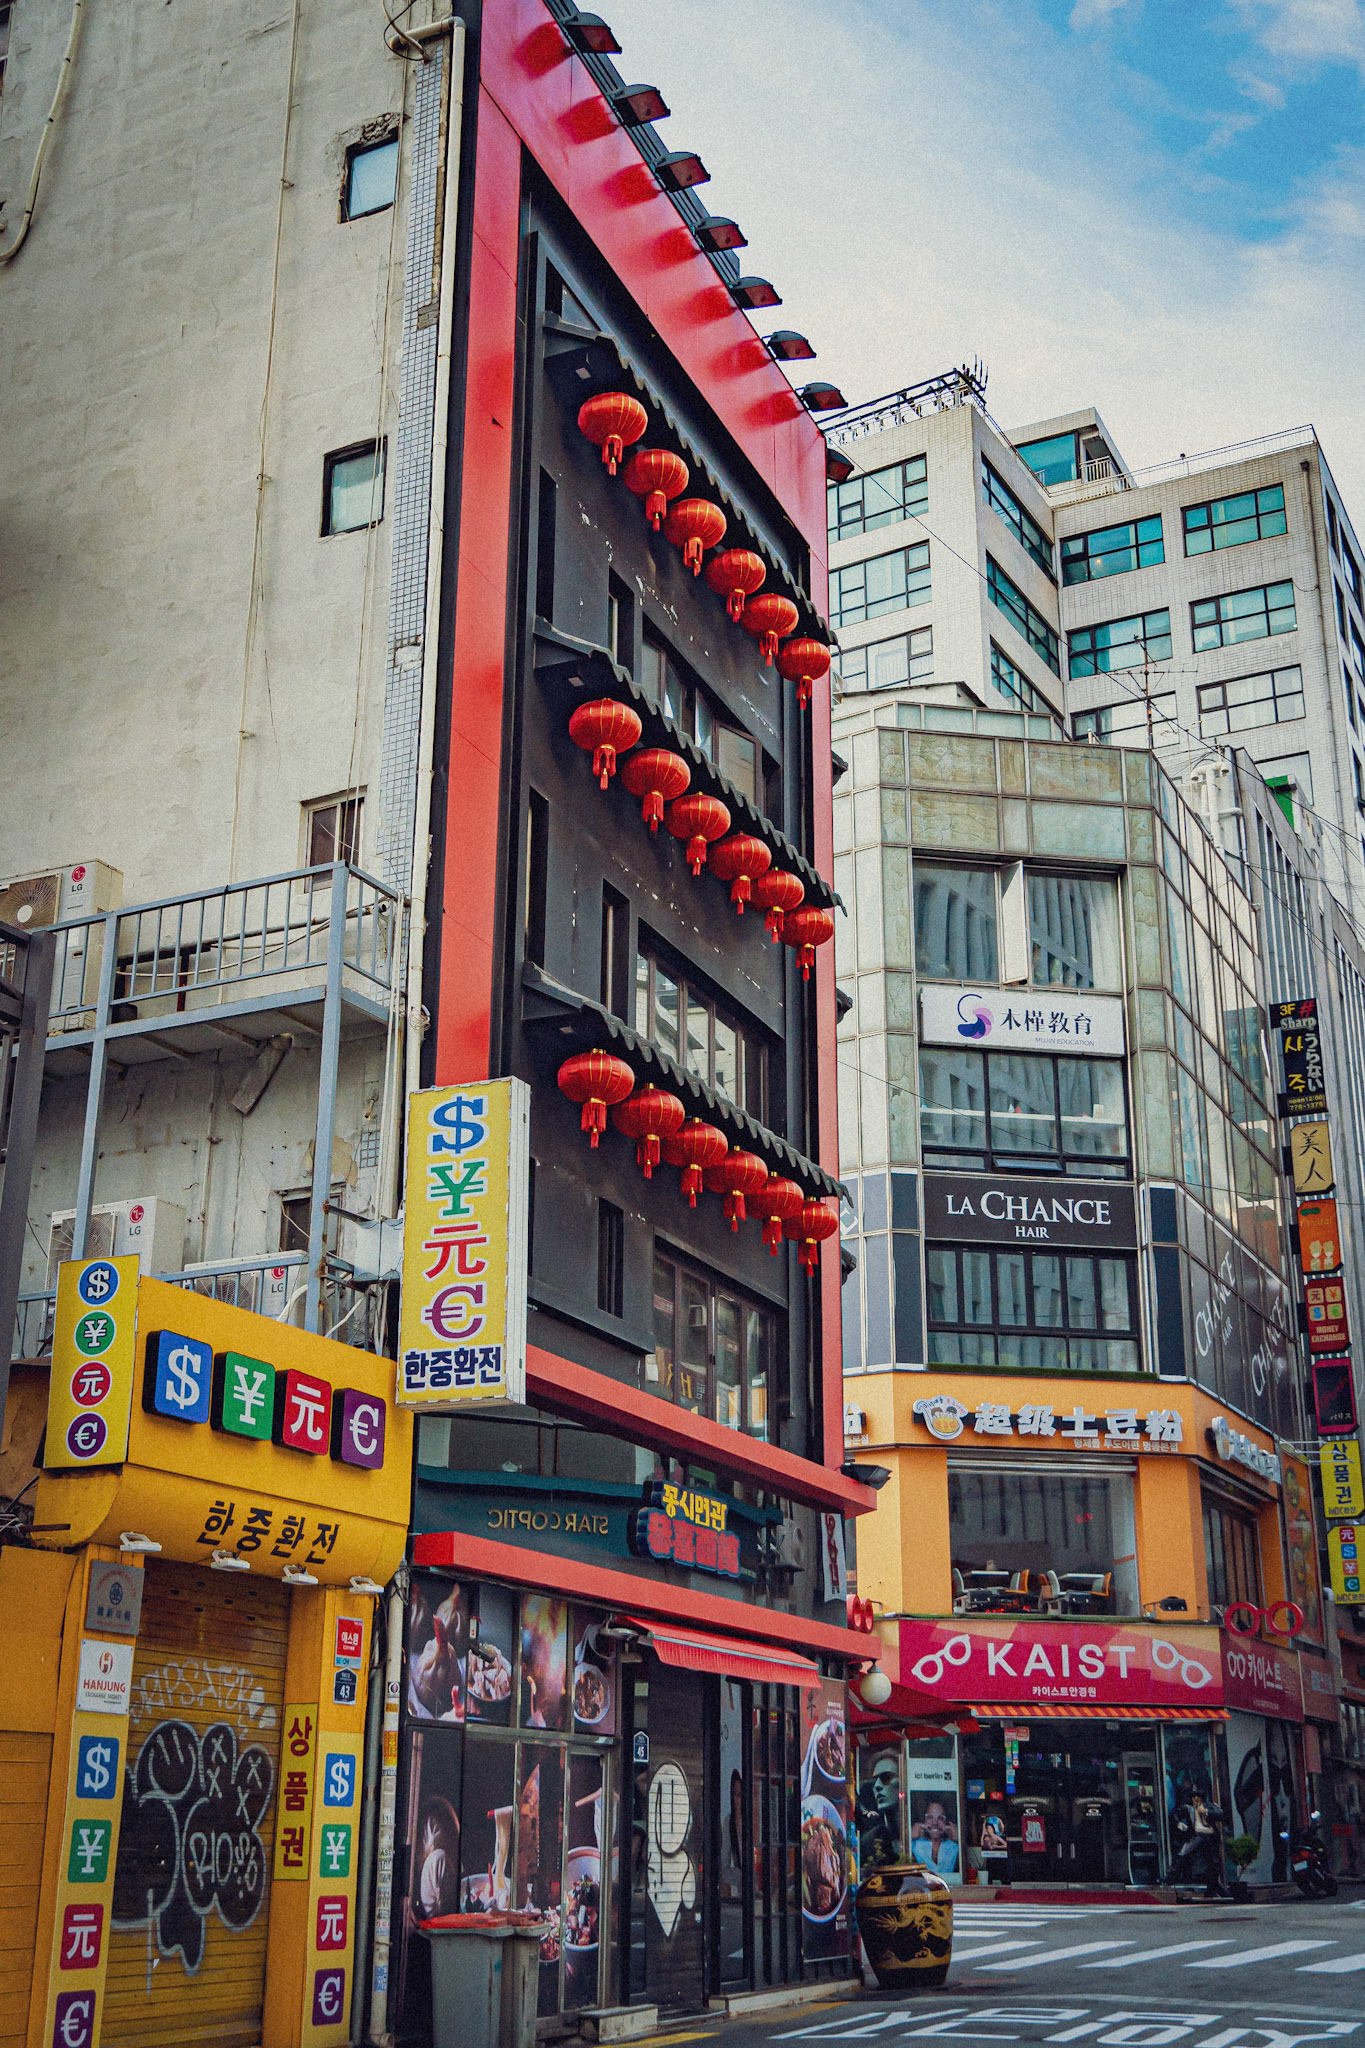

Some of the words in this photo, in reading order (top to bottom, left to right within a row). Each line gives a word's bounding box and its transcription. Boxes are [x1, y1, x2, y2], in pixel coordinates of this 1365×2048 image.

[71, 883, 83, 892] LG
[1001, 1008, 1091, 1035] 木槿教育
[1280, 1004, 1295, 1016] 3F
[1280, 1017, 1316, 1031] Sharp
[1057, 1038, 1095, 1047] EDUCATION
[1285, 1036, 1306, 1092] 사주
[1304, 1033, 1322, 1092] うらない
[433, 1096, 484, 1154] $
[1299, 1130, 1326, 1184] 美人
[431, 1161, 484, 1216] ¥
[946, 1195, 976, 1216] LA
[980, 1191, 1112, 1225] CHANCE
[129, 1226, 142, 1236] LG
[1015, 1226, 1049, 1239] HAIR
[425, 1224, 487, 1278] 元
[87, 1269, 110, 1299] $
[271, 1283, 284, 1294] LG
[1310, 1290, 1320, 1300] 元
[1328, 1288, 1338, 1300] ¥
[425, 1284, 483, 1338] €
[1316, 1324, 1339, 1334] MONEY
[84, 1319, 108, 1347] ¥
[1311, 1332, 1346, 1342] EXCHANGE
[78, 1370, 104, 1398] 元
[165, 1346, 201, 1409] $
[404, 1346, 502, 1389] 한중환전
[233, 1365, 268, 1426] ¥
[290, 1388, 326, 1440] 元
[349, 1404, 380, 1456] €
[974, 1402, 1184, 1442] 超级土豆粉
[1330, 1412, 1352, 1420] パリス
[74, 1422, 98, 1450] €
[1332, 1444, 1352, 1504] 상품권
[198, 1501, 340, 1564] 한중환전
[1340, 1528, 1354, 1540] 元
[341, 1632, 359, 1646] 에스원
[987, 1643, 1136, 1679] KAIST
[1248, 1654, 1283, 1690] 카이스트
[83, 1678, 126, 1694] HANJUNG
[106, 1692, 122, 1700] MONEY
[340, 1684, 350, 1698] 43
[1032, 1686, 1096, 1698] 카이스트안경원
[84, 1743, 110, 1792] $
[330, 1759, 350, 1802] $
[281, 1716, 312, 1868] 상품권
[77, 1828, 103, 1874] ¥
[326, 1831, 346, 1870] ¥
[66, 1914, 96, 1960] 元
[320, 1904, 344, 1943] 元
[318, 1976, 341, 2017] €
[60, 2000, 90, 2048] €
